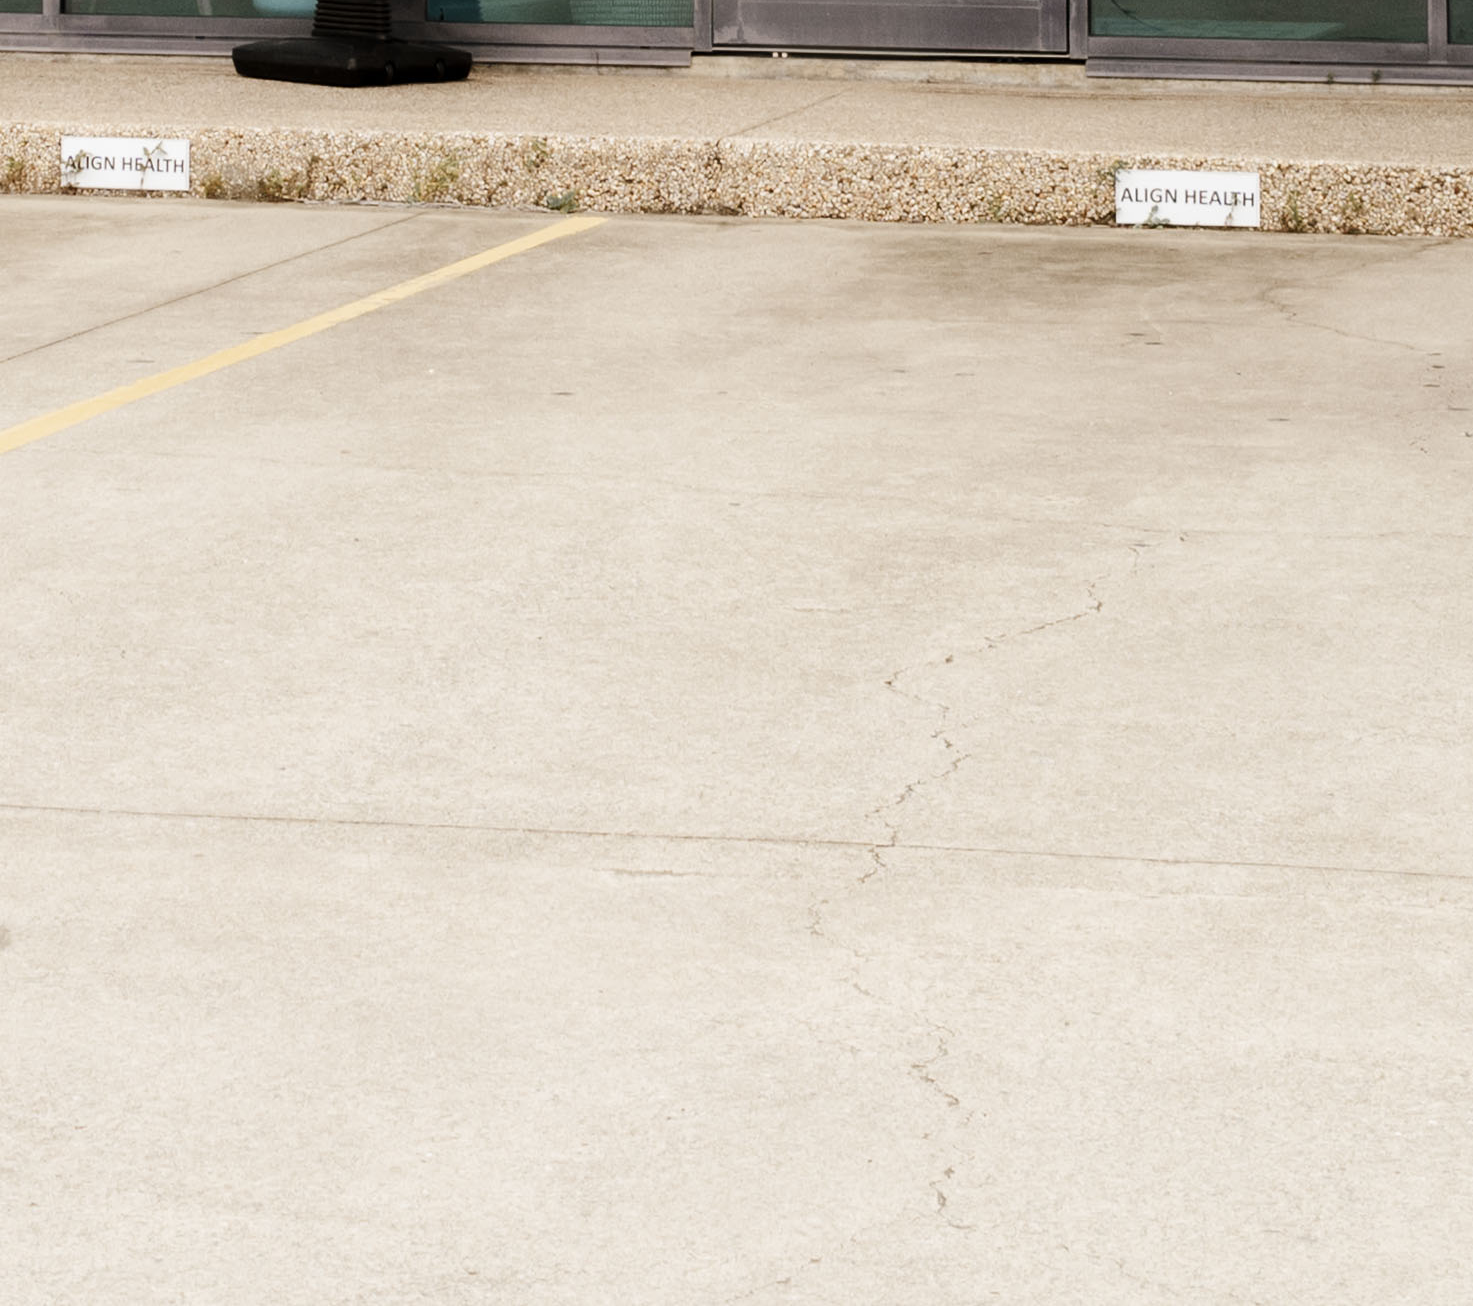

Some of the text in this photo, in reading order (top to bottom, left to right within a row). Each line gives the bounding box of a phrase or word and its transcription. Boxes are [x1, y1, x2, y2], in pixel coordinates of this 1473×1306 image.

[66, 155, 184, 173] ALIGN HEALTH
[1121, 188, 1254, 207] ALIGN HEALTH
